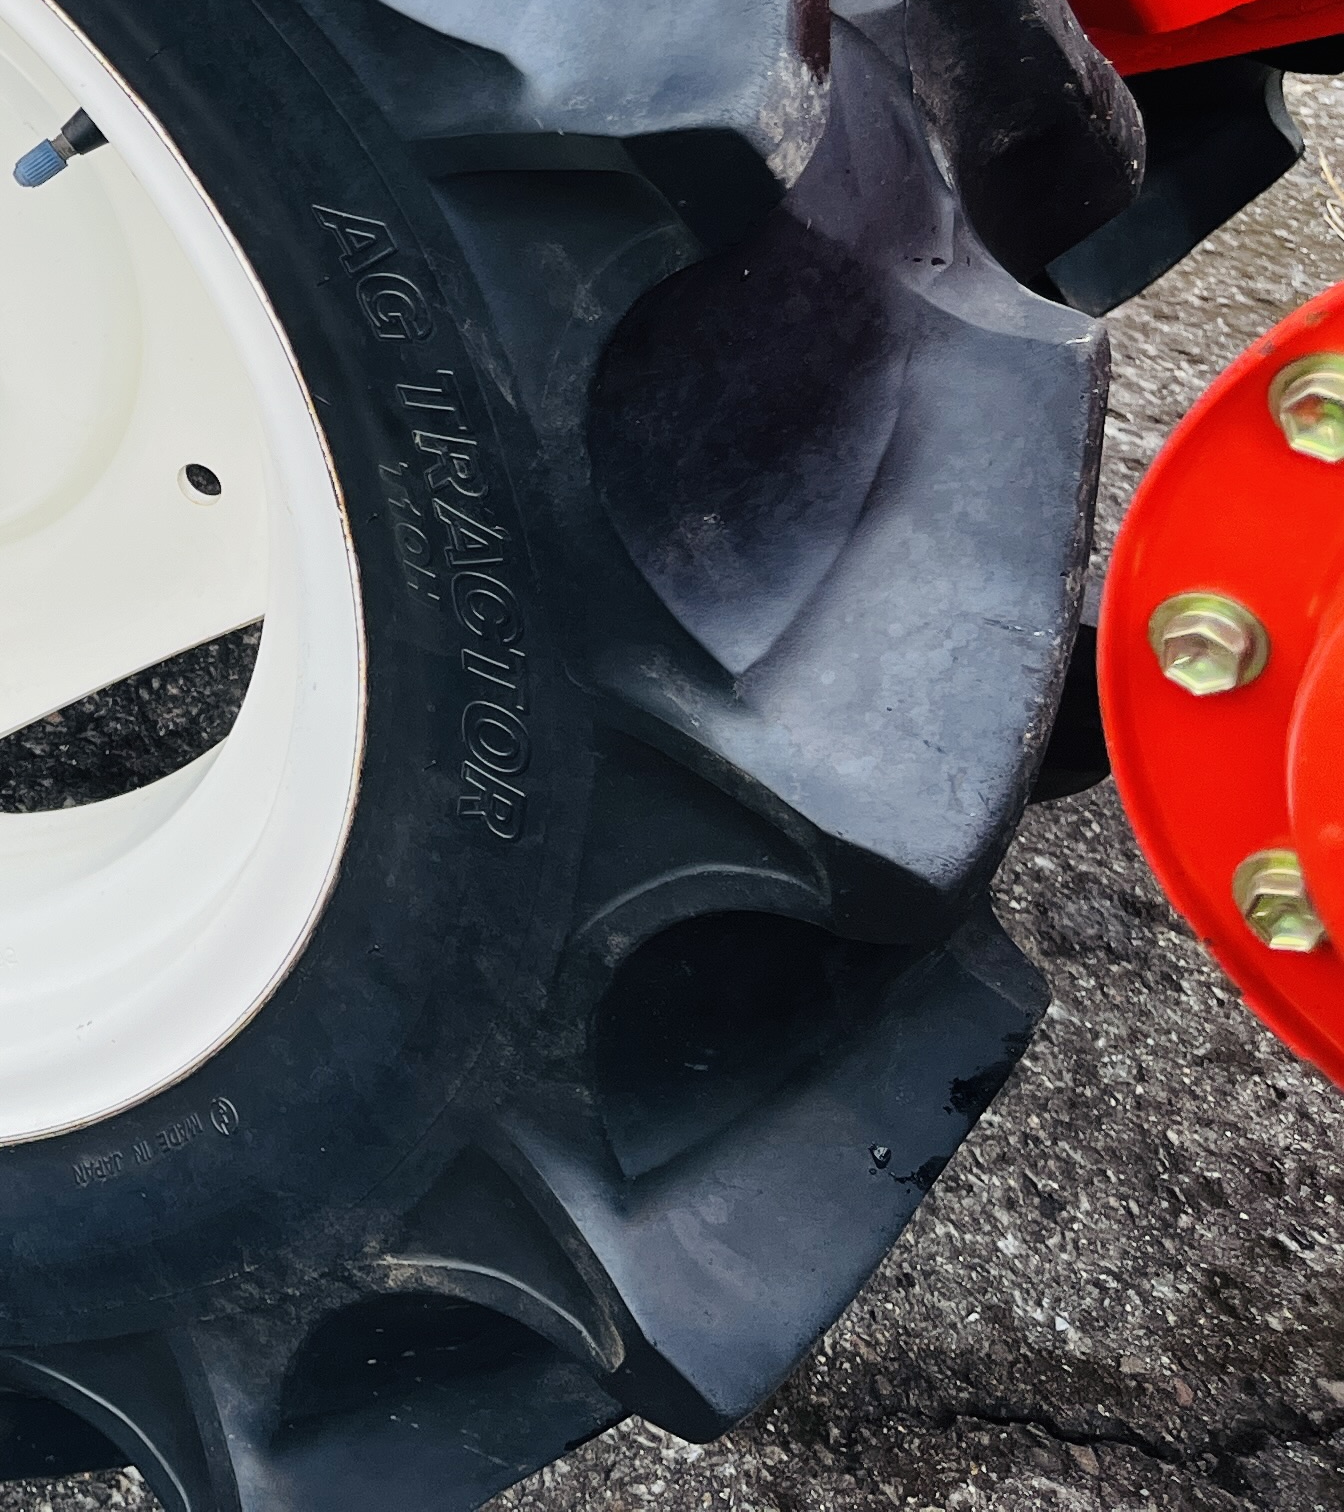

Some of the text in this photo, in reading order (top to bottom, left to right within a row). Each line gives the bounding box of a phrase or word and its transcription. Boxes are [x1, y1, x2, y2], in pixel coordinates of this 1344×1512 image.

[311, 203, 531, 841] AG TRACTOR
[71, 1111, 205, 1188] MADE IN JAPAN
